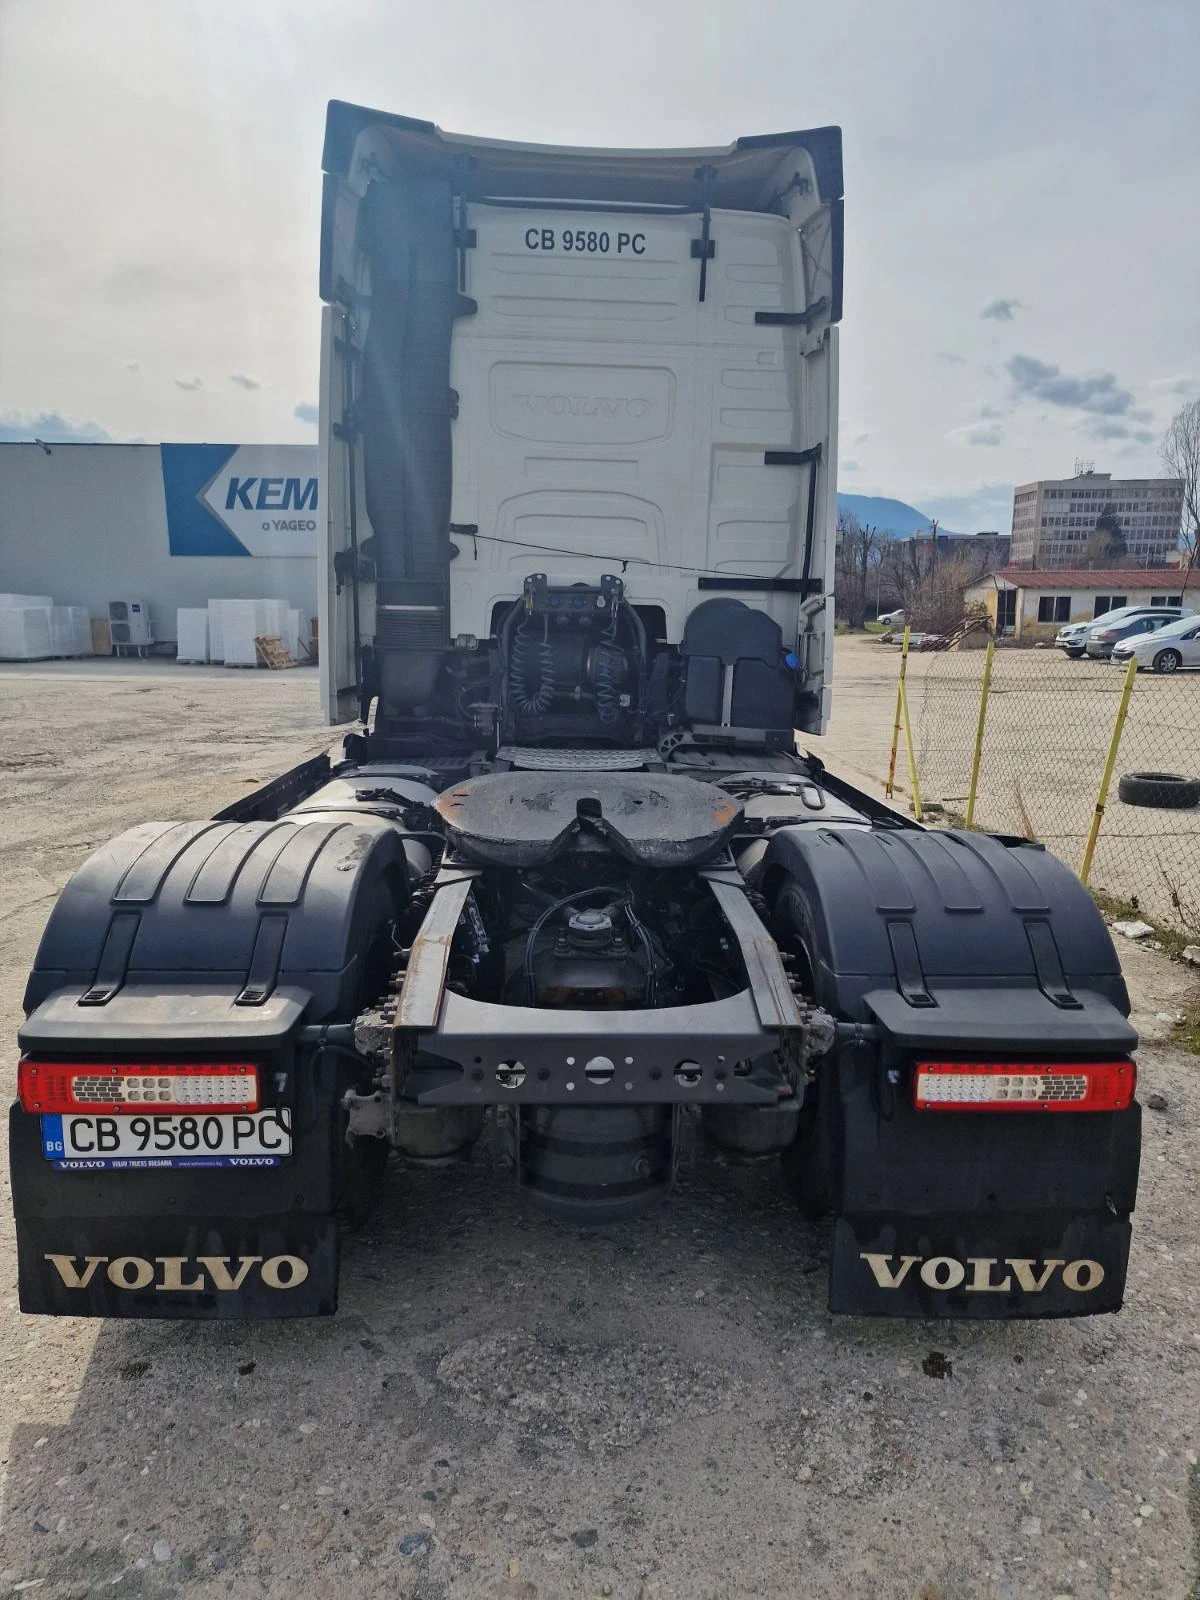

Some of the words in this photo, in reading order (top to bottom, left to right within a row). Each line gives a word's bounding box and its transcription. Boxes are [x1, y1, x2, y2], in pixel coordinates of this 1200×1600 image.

[525, 228, 555, 250] CB
[562, 230, 610, 252] 9580
[617, 233, 646, 254] PC
[272, 519, 316, 531] YAGEO
[46, 1141, 63, 1151] BG
[69, 1117, 121, 1152] CB
[129, 1116, 224, 1151] 9580
[232, 1115, 282, 1149] PC
[60, 1160, 106, 1169] VOLVO
[229, 1157, 274, 1166] VOLVO
[44, 1253, 309, 1291] VOLVO
[859, 1252, 1105, 1293] VOLVO
